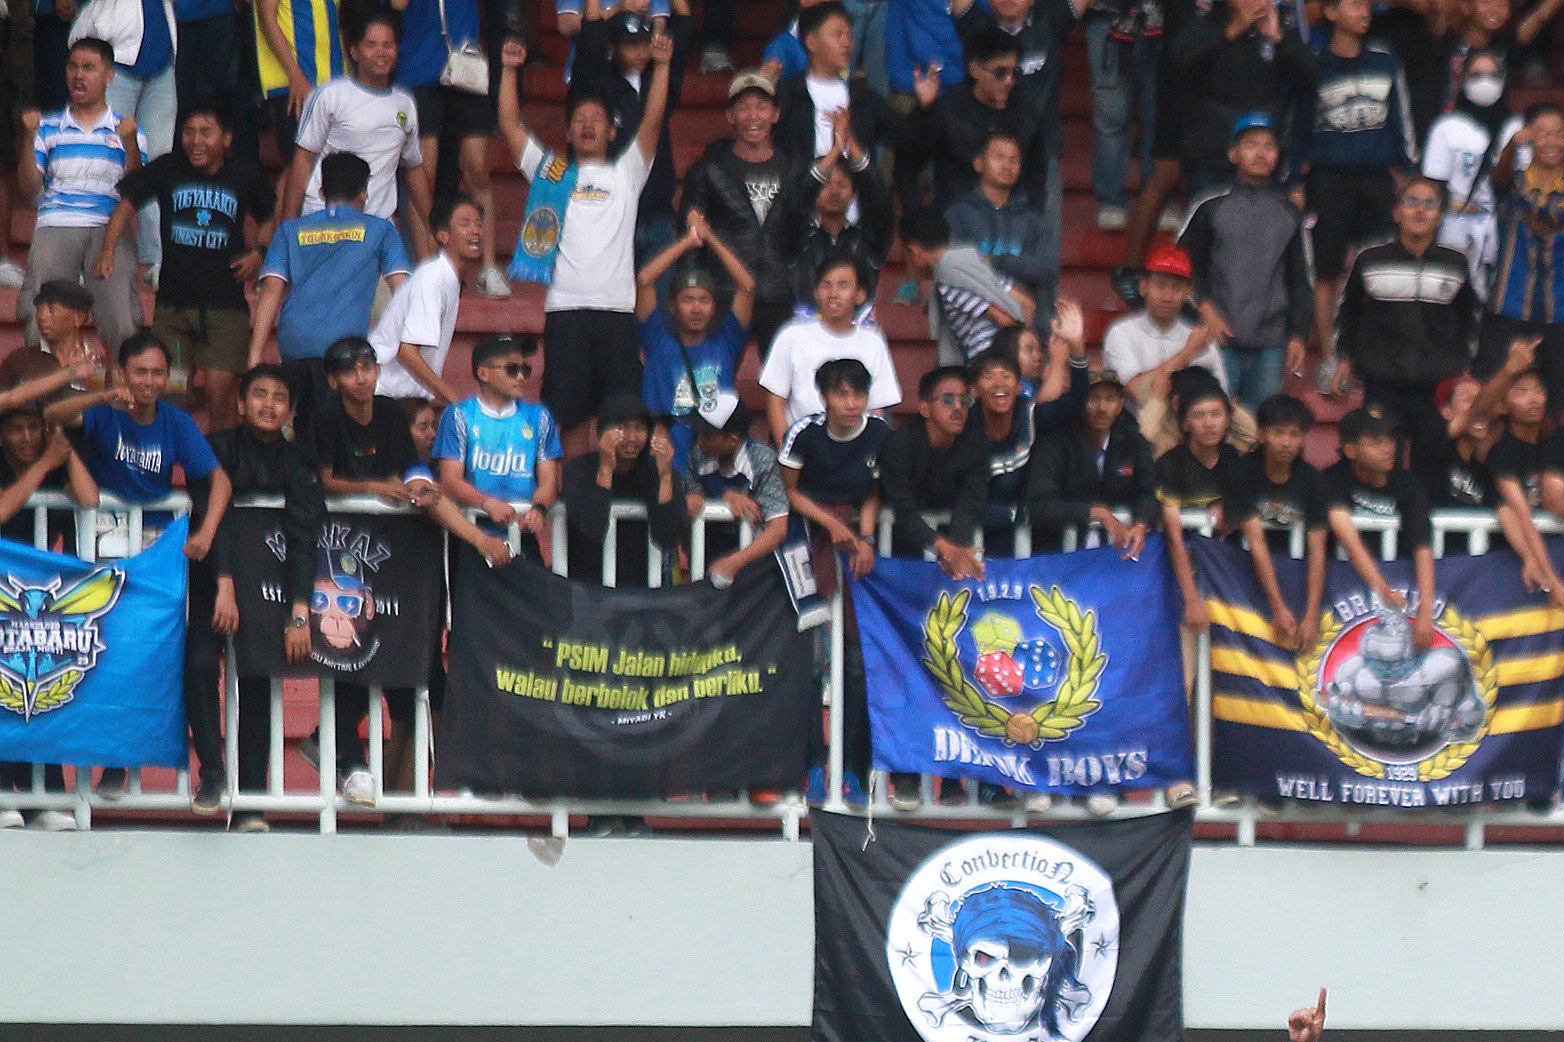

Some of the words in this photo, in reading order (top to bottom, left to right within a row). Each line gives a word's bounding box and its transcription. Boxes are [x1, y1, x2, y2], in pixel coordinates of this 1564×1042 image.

[265, 522, 391, 573] MRKAZ
[0, 628, 93, 655] TABARU
[612, 650, 666, 677] Jalan
[496, 667, 558, 701] walau
[561, 677, 649, 710] berbelok
[653, 685, 689, 708] dan
[1047, 749, 1149, 787] BOYS
[1276, 776, 1334, 802] WELL
[1341, 783, 1427, 807] FOREVER
[1432, 783, 1484, 806] WITH
[1489, 778, 1526, 801] YOU
